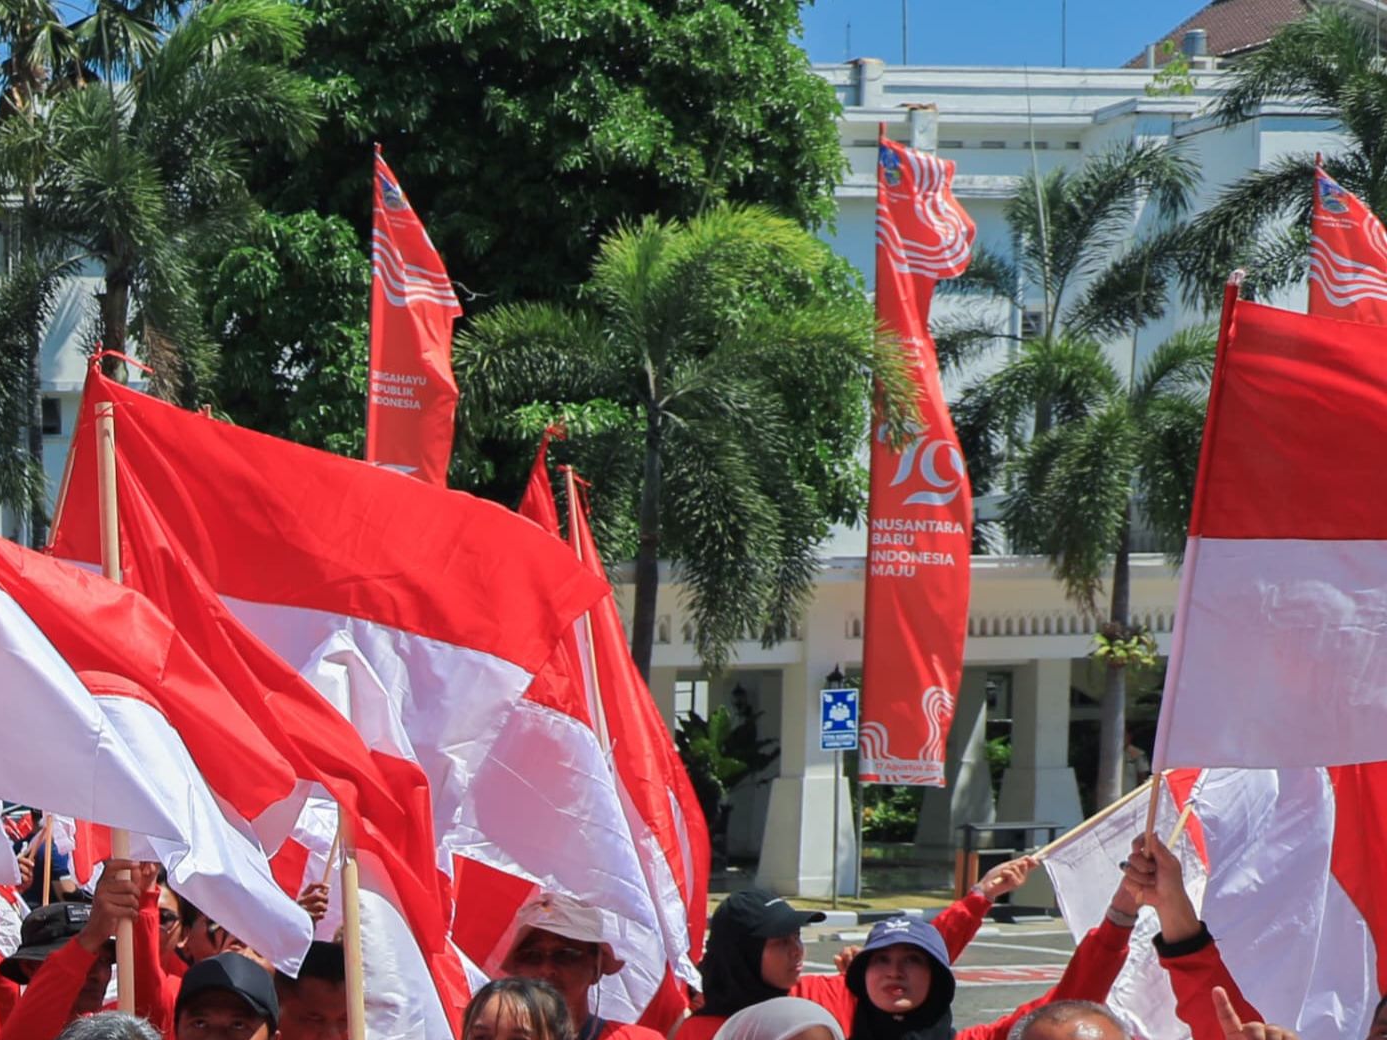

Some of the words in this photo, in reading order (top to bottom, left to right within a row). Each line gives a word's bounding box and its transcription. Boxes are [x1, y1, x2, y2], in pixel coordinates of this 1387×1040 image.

[871, 518, 964, 534] NUSANTARA
[871, 532, 914, 546] BARU
[870, 550, 955, 566] INDONESIA
[870, 564, 916, 577] MAJU
